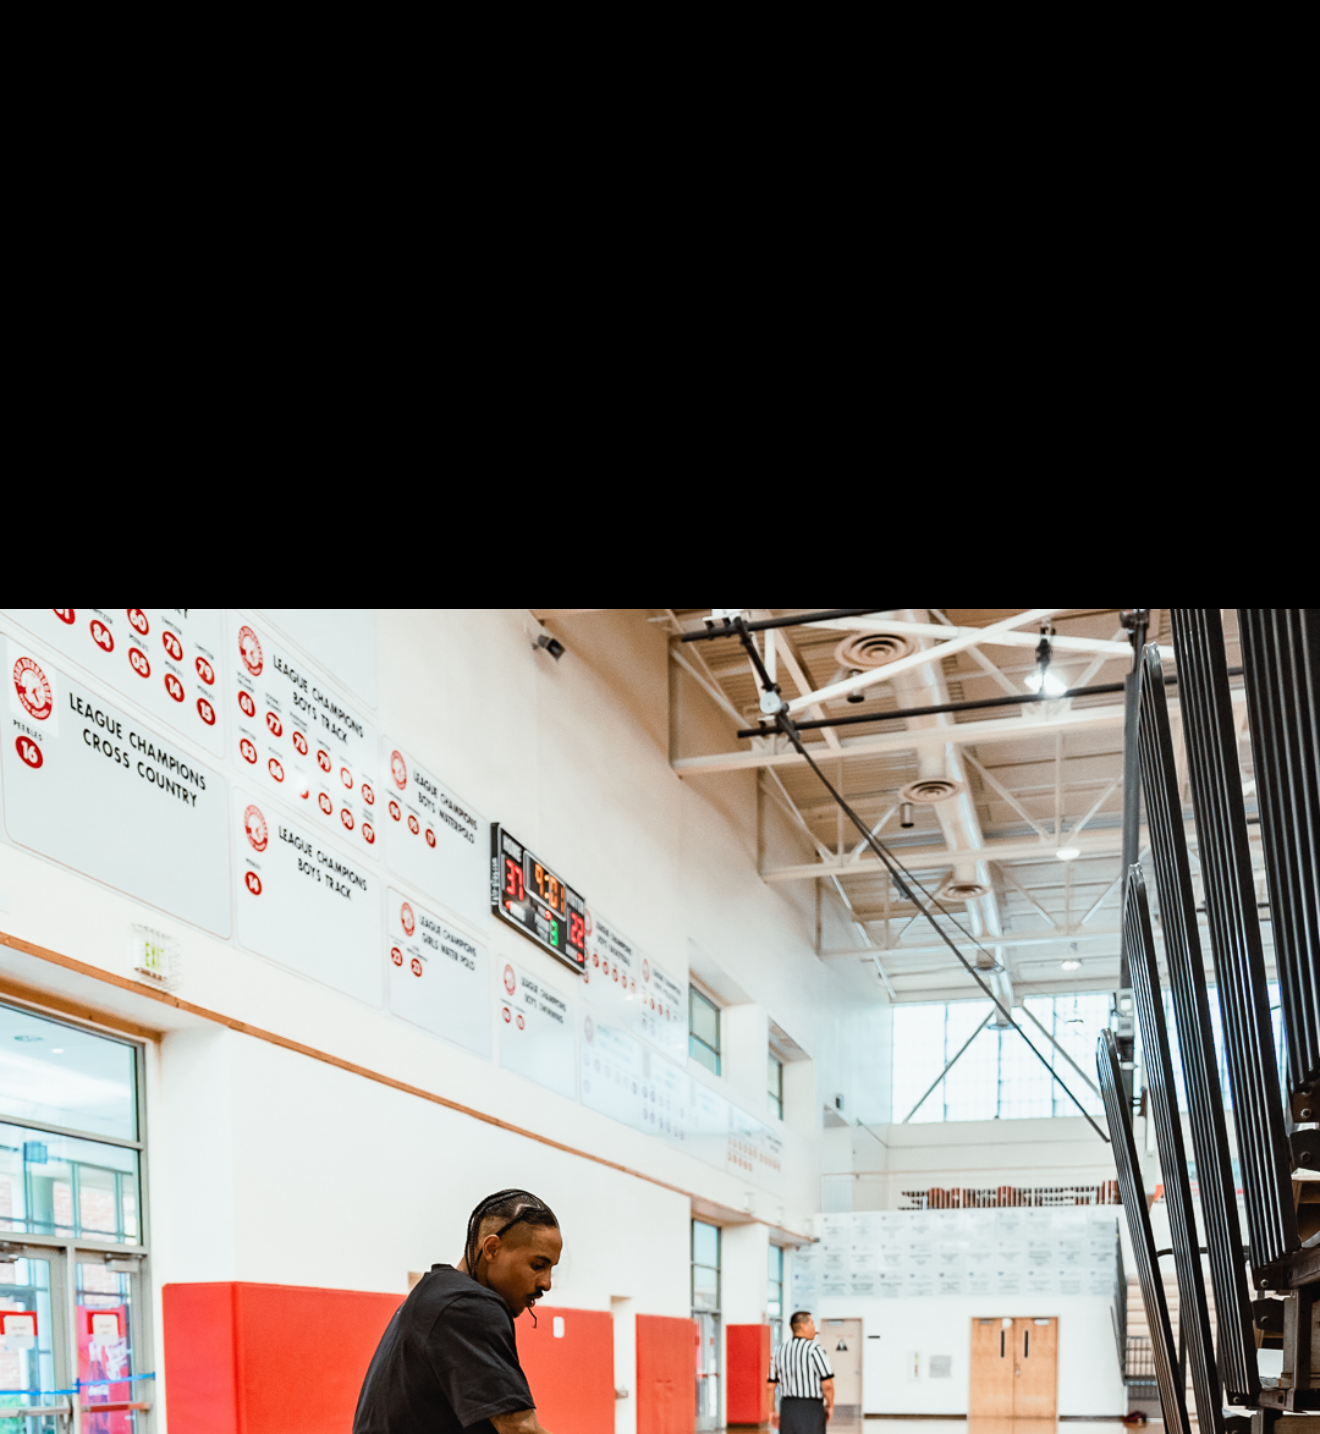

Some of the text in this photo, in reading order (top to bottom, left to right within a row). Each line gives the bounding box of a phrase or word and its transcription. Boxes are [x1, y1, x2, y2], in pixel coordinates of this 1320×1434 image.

[272, 654, 308, 694] LEAGUE
[311, 687, 364, 738] CHAMPIONS
[292, 691, 318, 721] BOYS
[320, 713, 348, 745] TRACK
[69, 692, 206, 791] LEAGUE CHAMPIONS
[82, 728, 197, 808] CROSS COUNTRY
[278, 825, 367, 891] LEAGUE CHAMPIONS
[298, 857, 352, 901] BOYS TRACK
